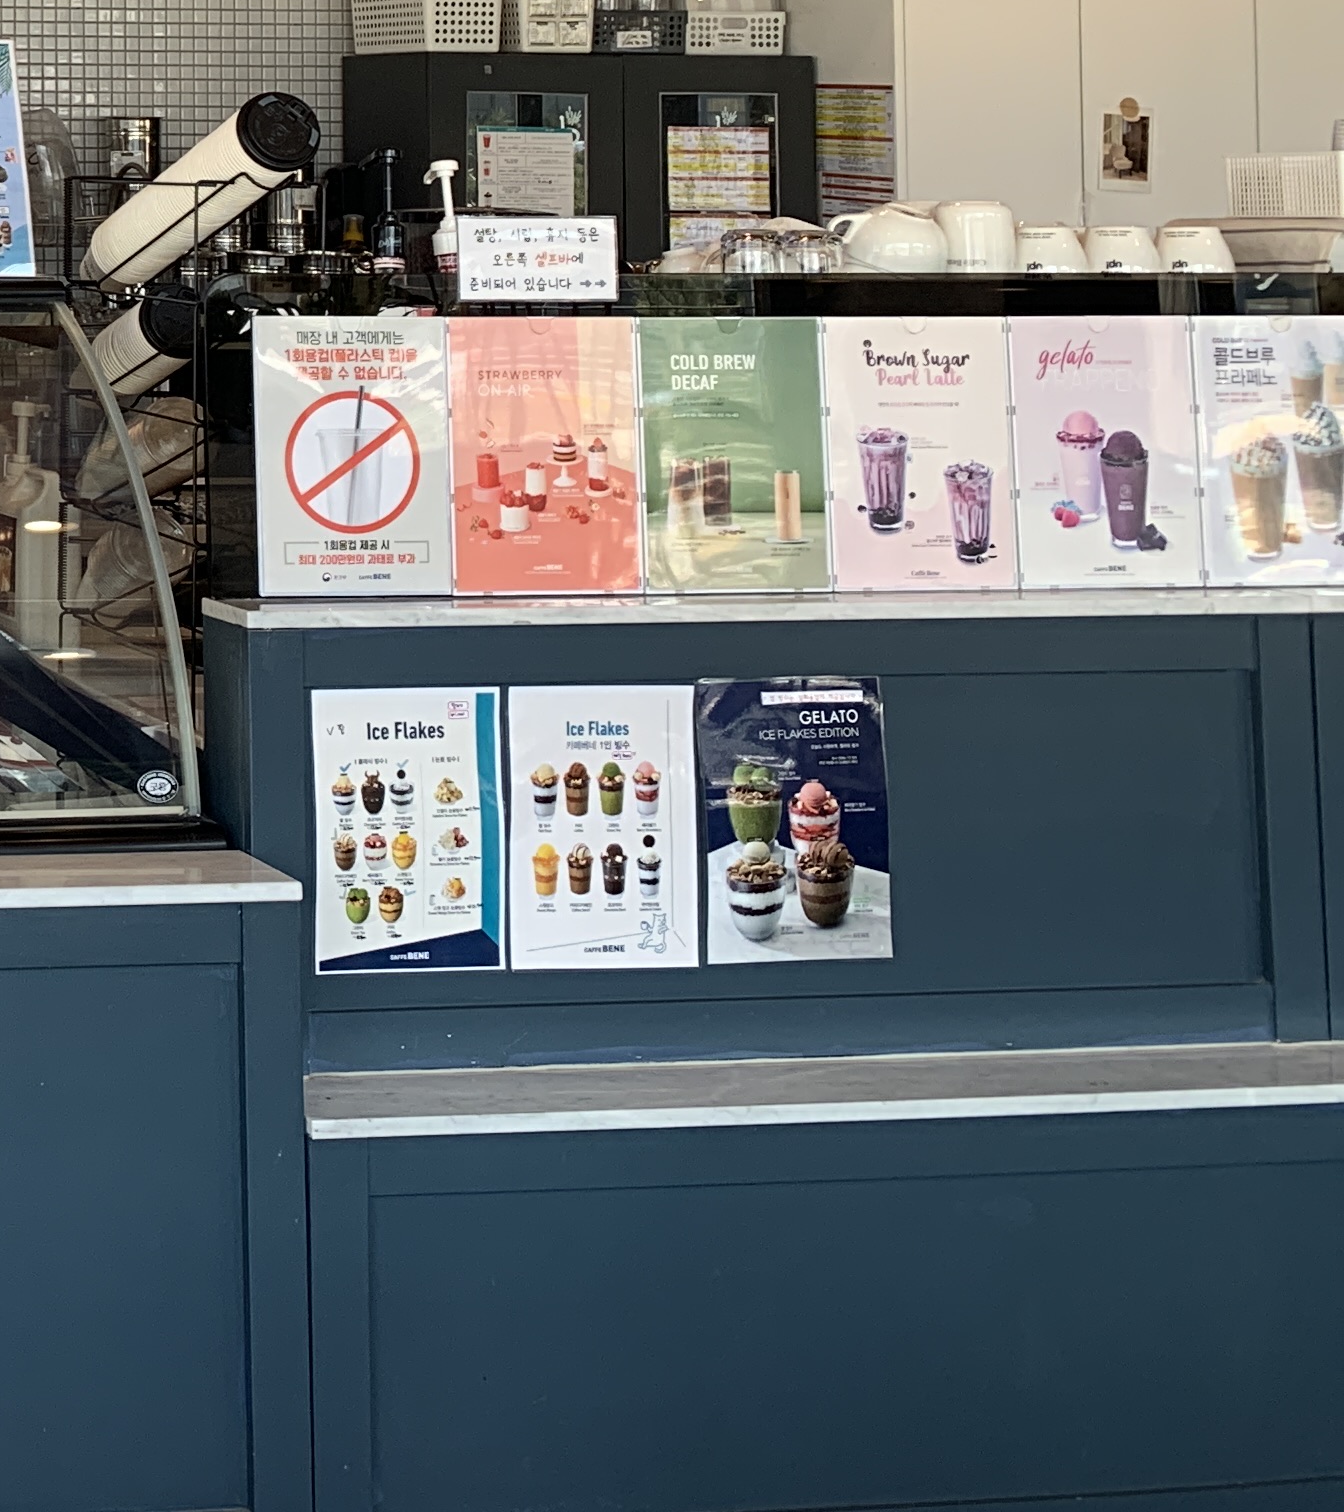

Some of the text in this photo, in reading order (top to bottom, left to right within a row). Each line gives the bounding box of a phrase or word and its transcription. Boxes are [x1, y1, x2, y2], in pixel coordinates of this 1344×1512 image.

[577, 227, 599, 243] 등은
[493, 252, 583, 267] 오른쪽 셀프바에
[470, 277, 571, 291] 준비되어 있습니다
[297, 331, 404, 345] 매장 내 고객에게는
[671, 355, 755, 370] COLD BREW
[863, 349, 970, 373] Brown Sugar
[1036, 340, 1095, 380] gelato
[1214, 347, 1275, 366] 콜드브루
[338, 367, 349, 380] 수
[478, 370, 562, 381] STRAWBERRY
[876, 368, 964, 386] Pearl Latte
[1215, 368, 1277, 386] 프라페노
[672, 375, 718, 390] DECAF
[478, 384, 533, 398] ON AIR
[324, 540, 389, 551] 1회용컵 제공 시
[299, 554, 415, 565] 최대 200만원의 과태료 부과
[799, 709, 858, 725] GELATO
[367, 721, 445, 740] Ice Flakes
[567, 721, 629, 736] Ice Flakes
[759, 727, 859, 740] ICE FLAKES EDITION
[566, 741, 630, 750] 카페베네 1인 빙수
[408, 952, 429, 960] BENE
